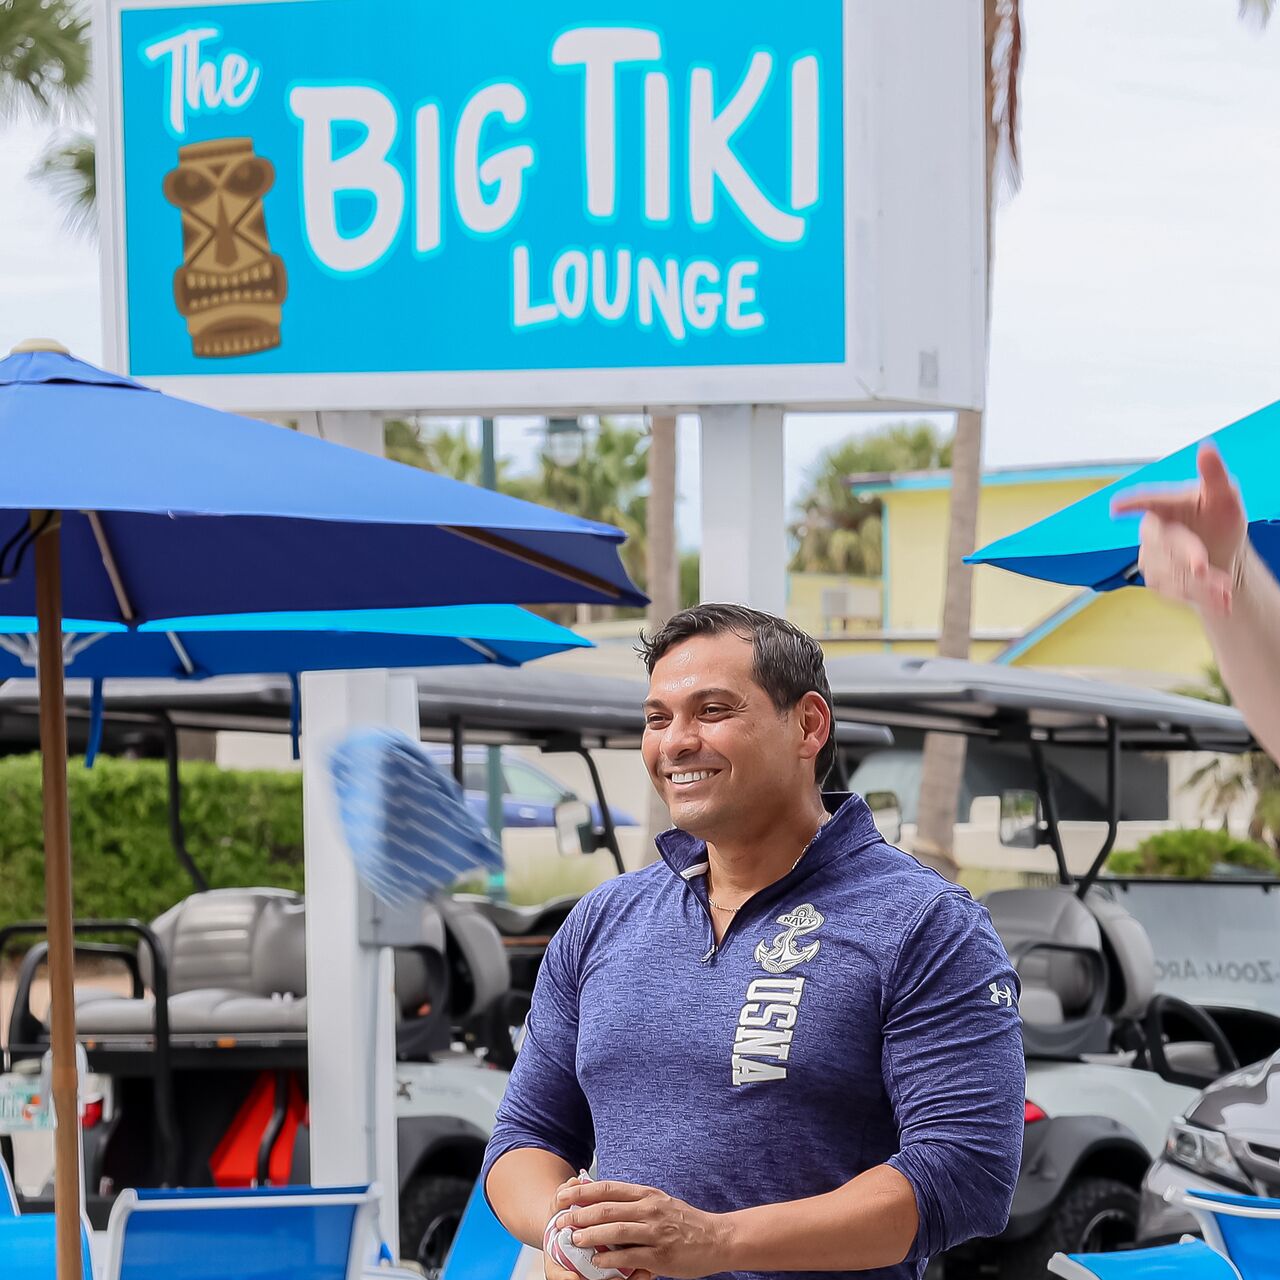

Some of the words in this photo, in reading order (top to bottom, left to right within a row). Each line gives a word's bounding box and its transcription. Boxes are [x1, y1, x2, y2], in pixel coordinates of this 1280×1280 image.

[144, 28, 259, 132] The
[290, 83, 535, 272] BIG
[552, 27, 820, 243] TIKI
[514, 246, 765, 340] LOUNGE
[783, 915, 815, 926] NAVY
[731, 975, 806, 1087] USNA
